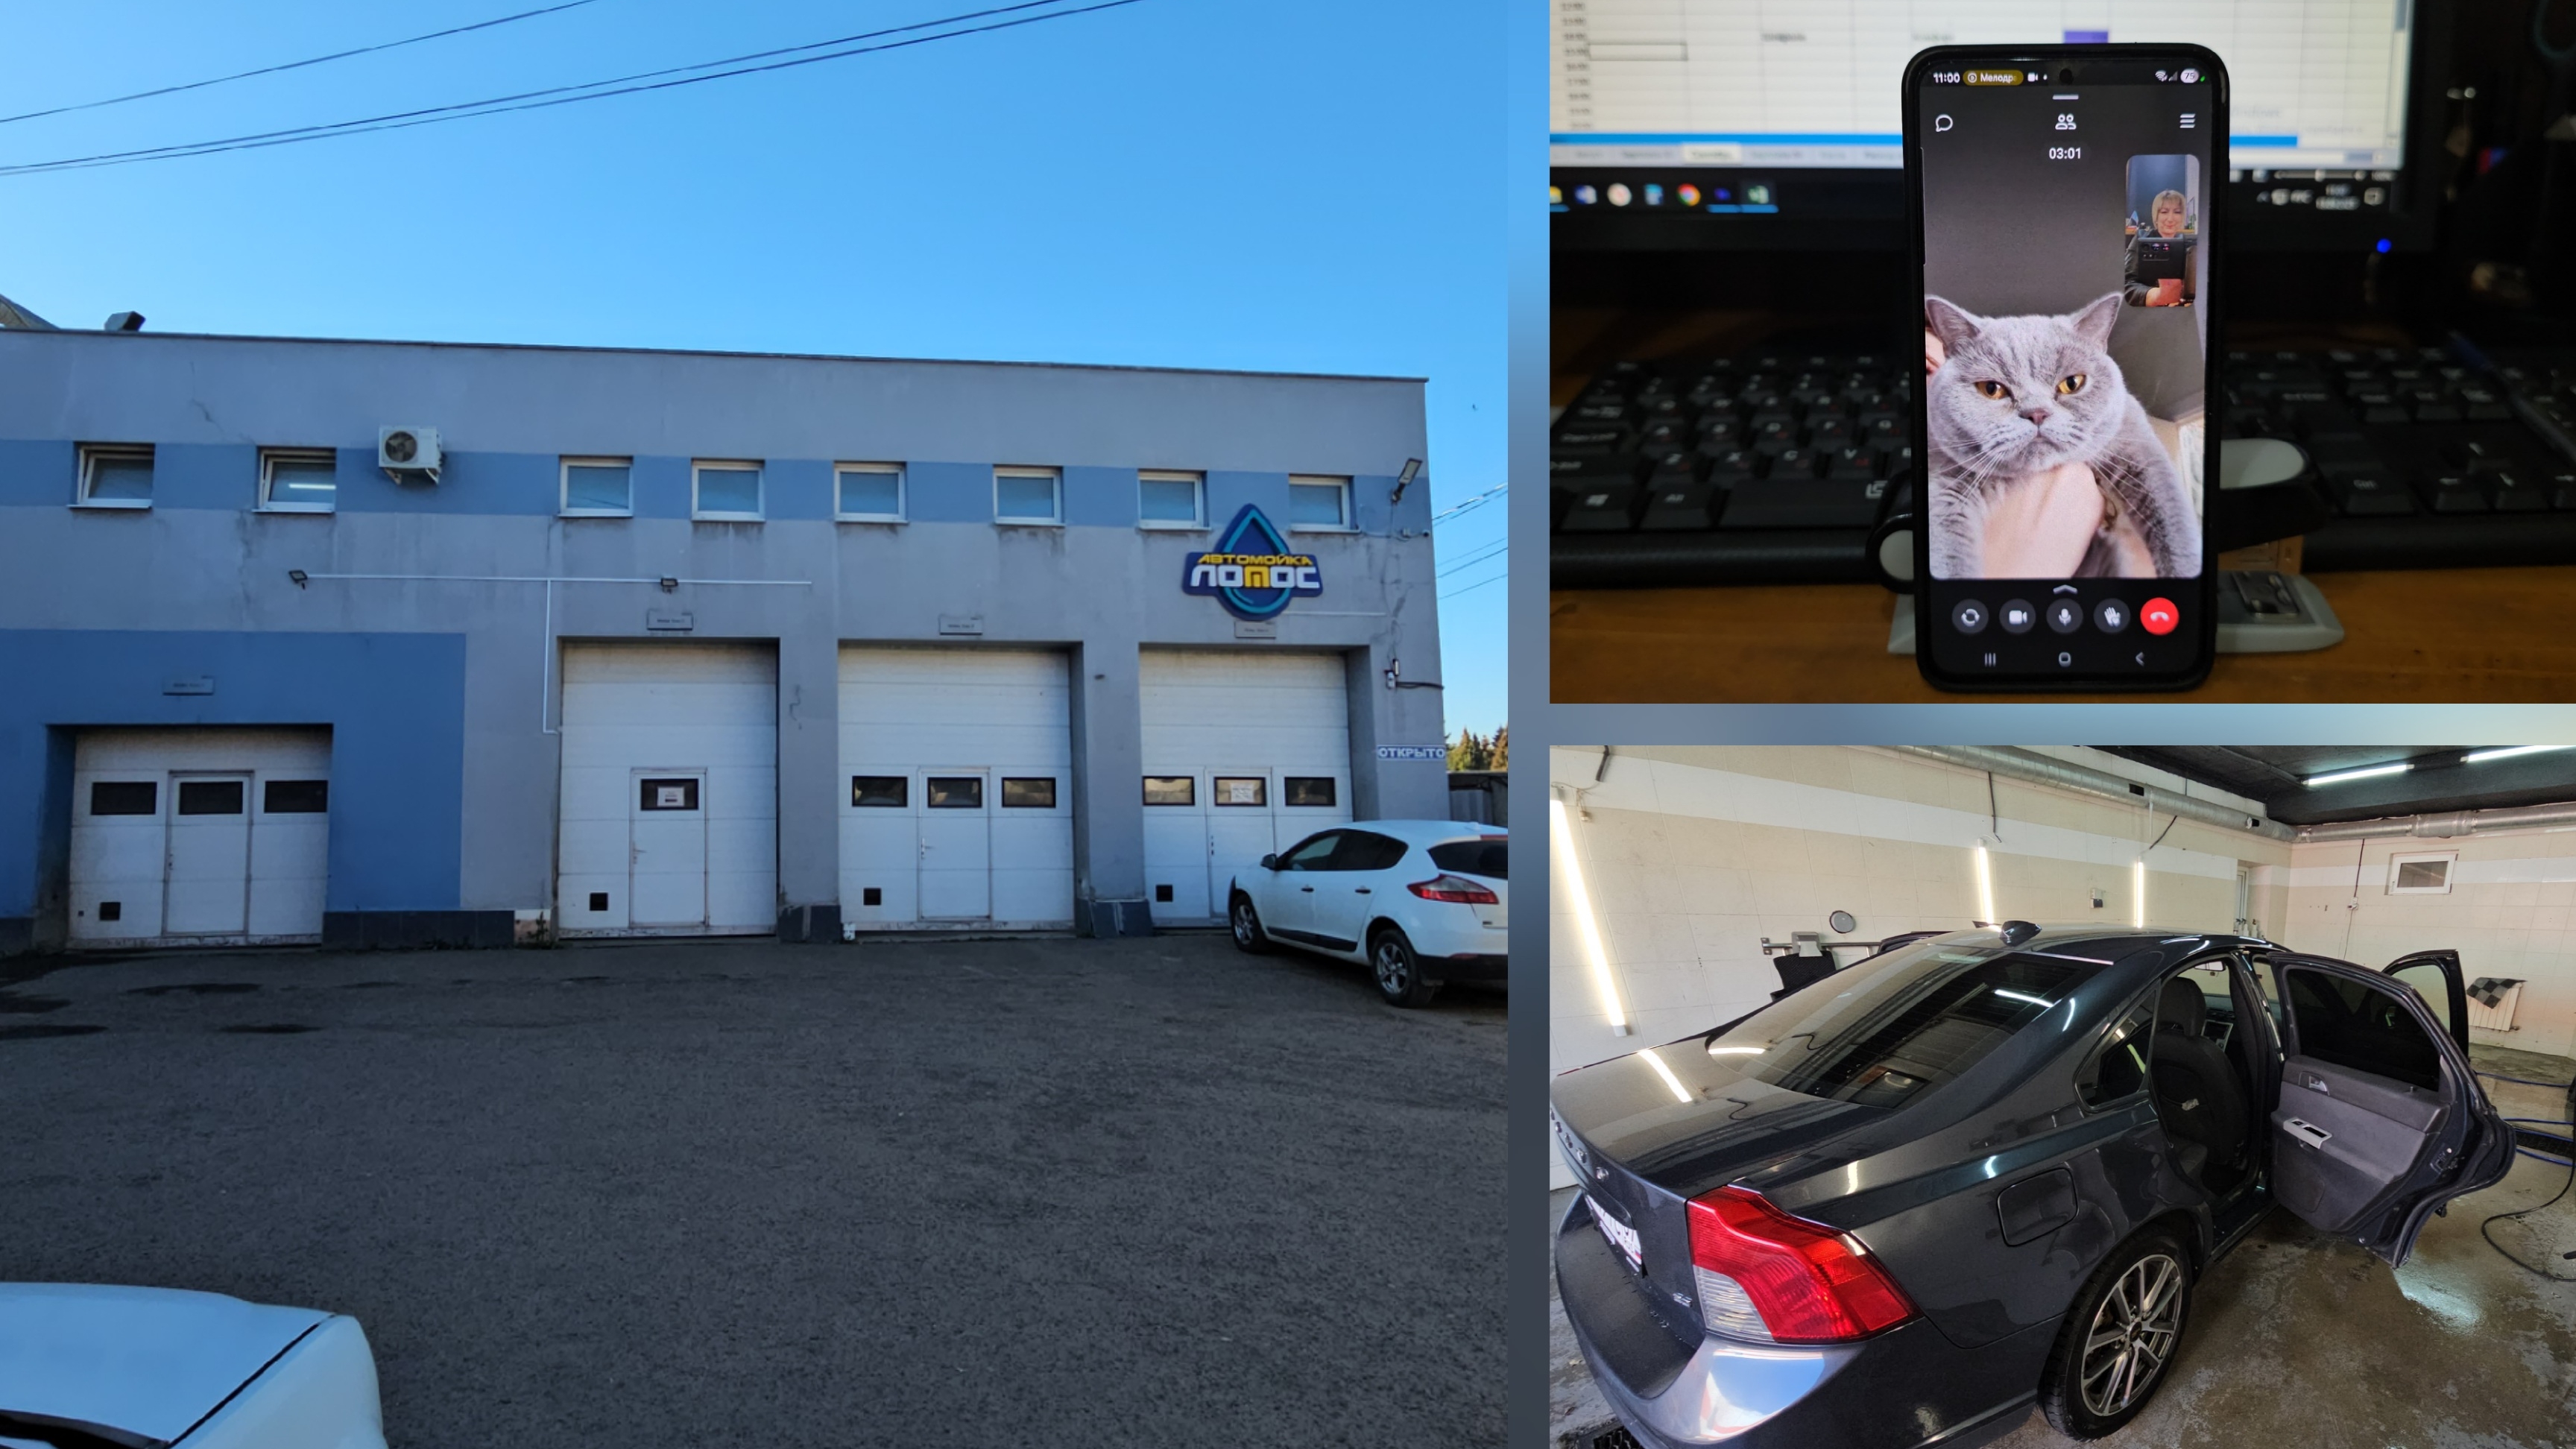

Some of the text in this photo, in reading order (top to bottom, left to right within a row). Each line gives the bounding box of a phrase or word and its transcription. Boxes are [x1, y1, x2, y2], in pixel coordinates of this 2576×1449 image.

[1933, 72, 1960, 83] 11:00
[2049, 147, 2081, 160] 03:01
[1197, 553, 1313, 566] АВТОМОЙКА
[1379, 748, 1445, 758] ОТКРЫТО
